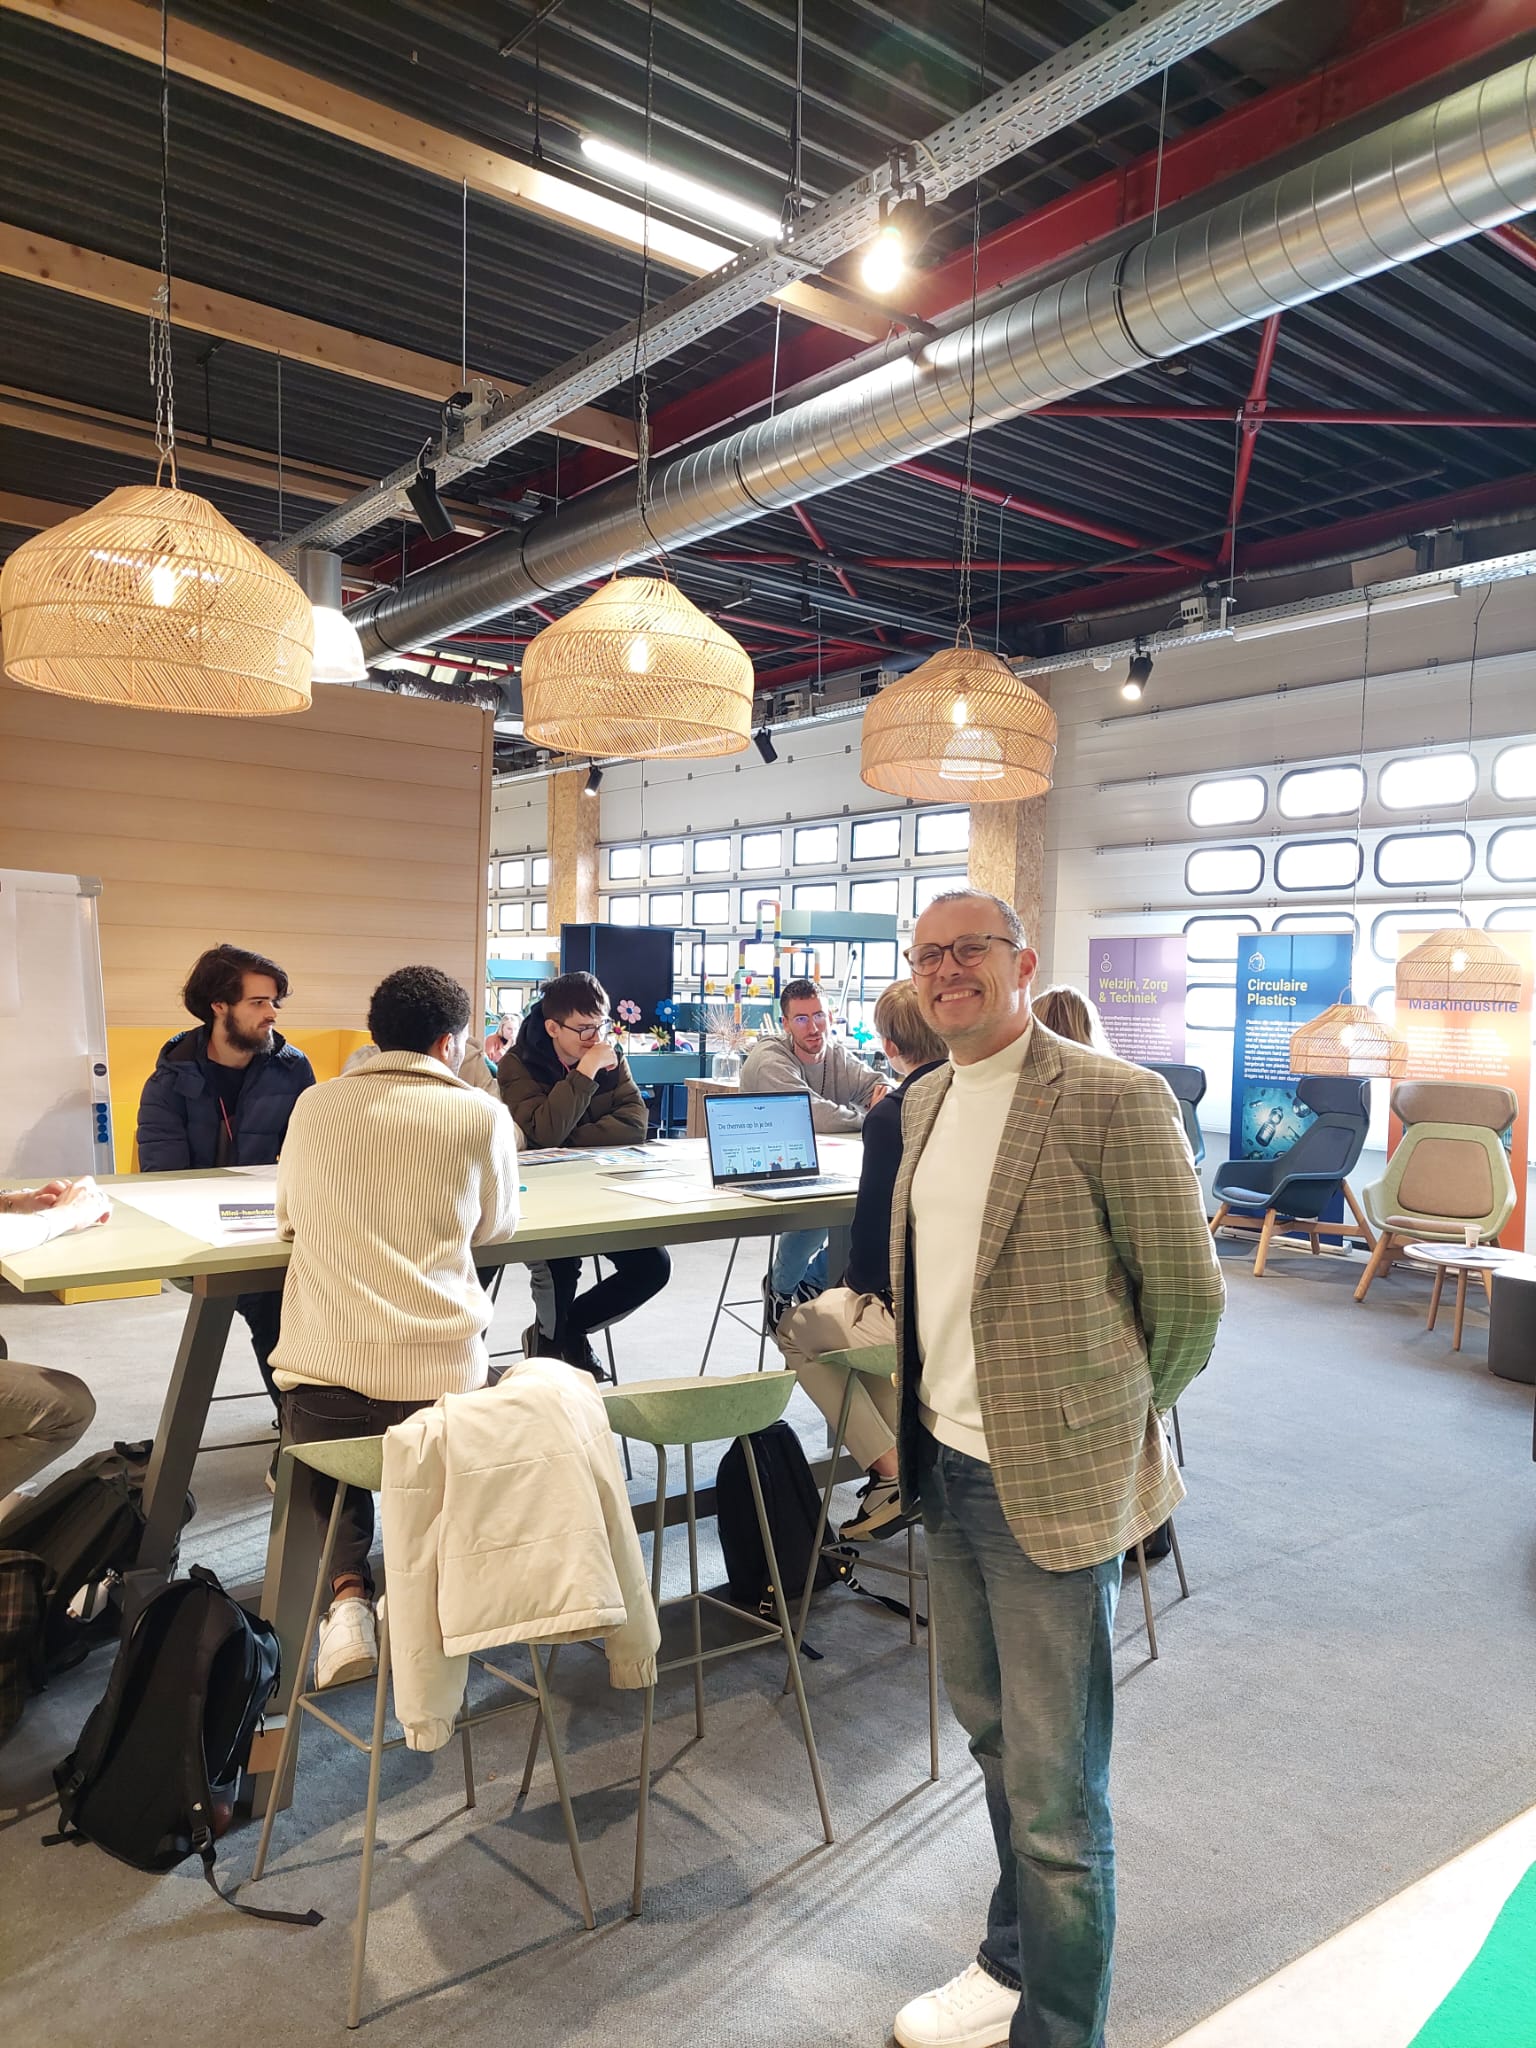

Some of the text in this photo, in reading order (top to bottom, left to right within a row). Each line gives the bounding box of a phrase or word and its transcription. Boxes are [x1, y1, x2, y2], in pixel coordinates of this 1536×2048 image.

[1099, 978, 1168, 992] Welzijn, Zorg
[1248, 979, 1308, 991] Circulaire
[1099, 992, 1157, 1004] & Techniek
[1247, 993, 1297, 1006] Plastics
[1409, 999, 1518, 1013] Maakindustrie
